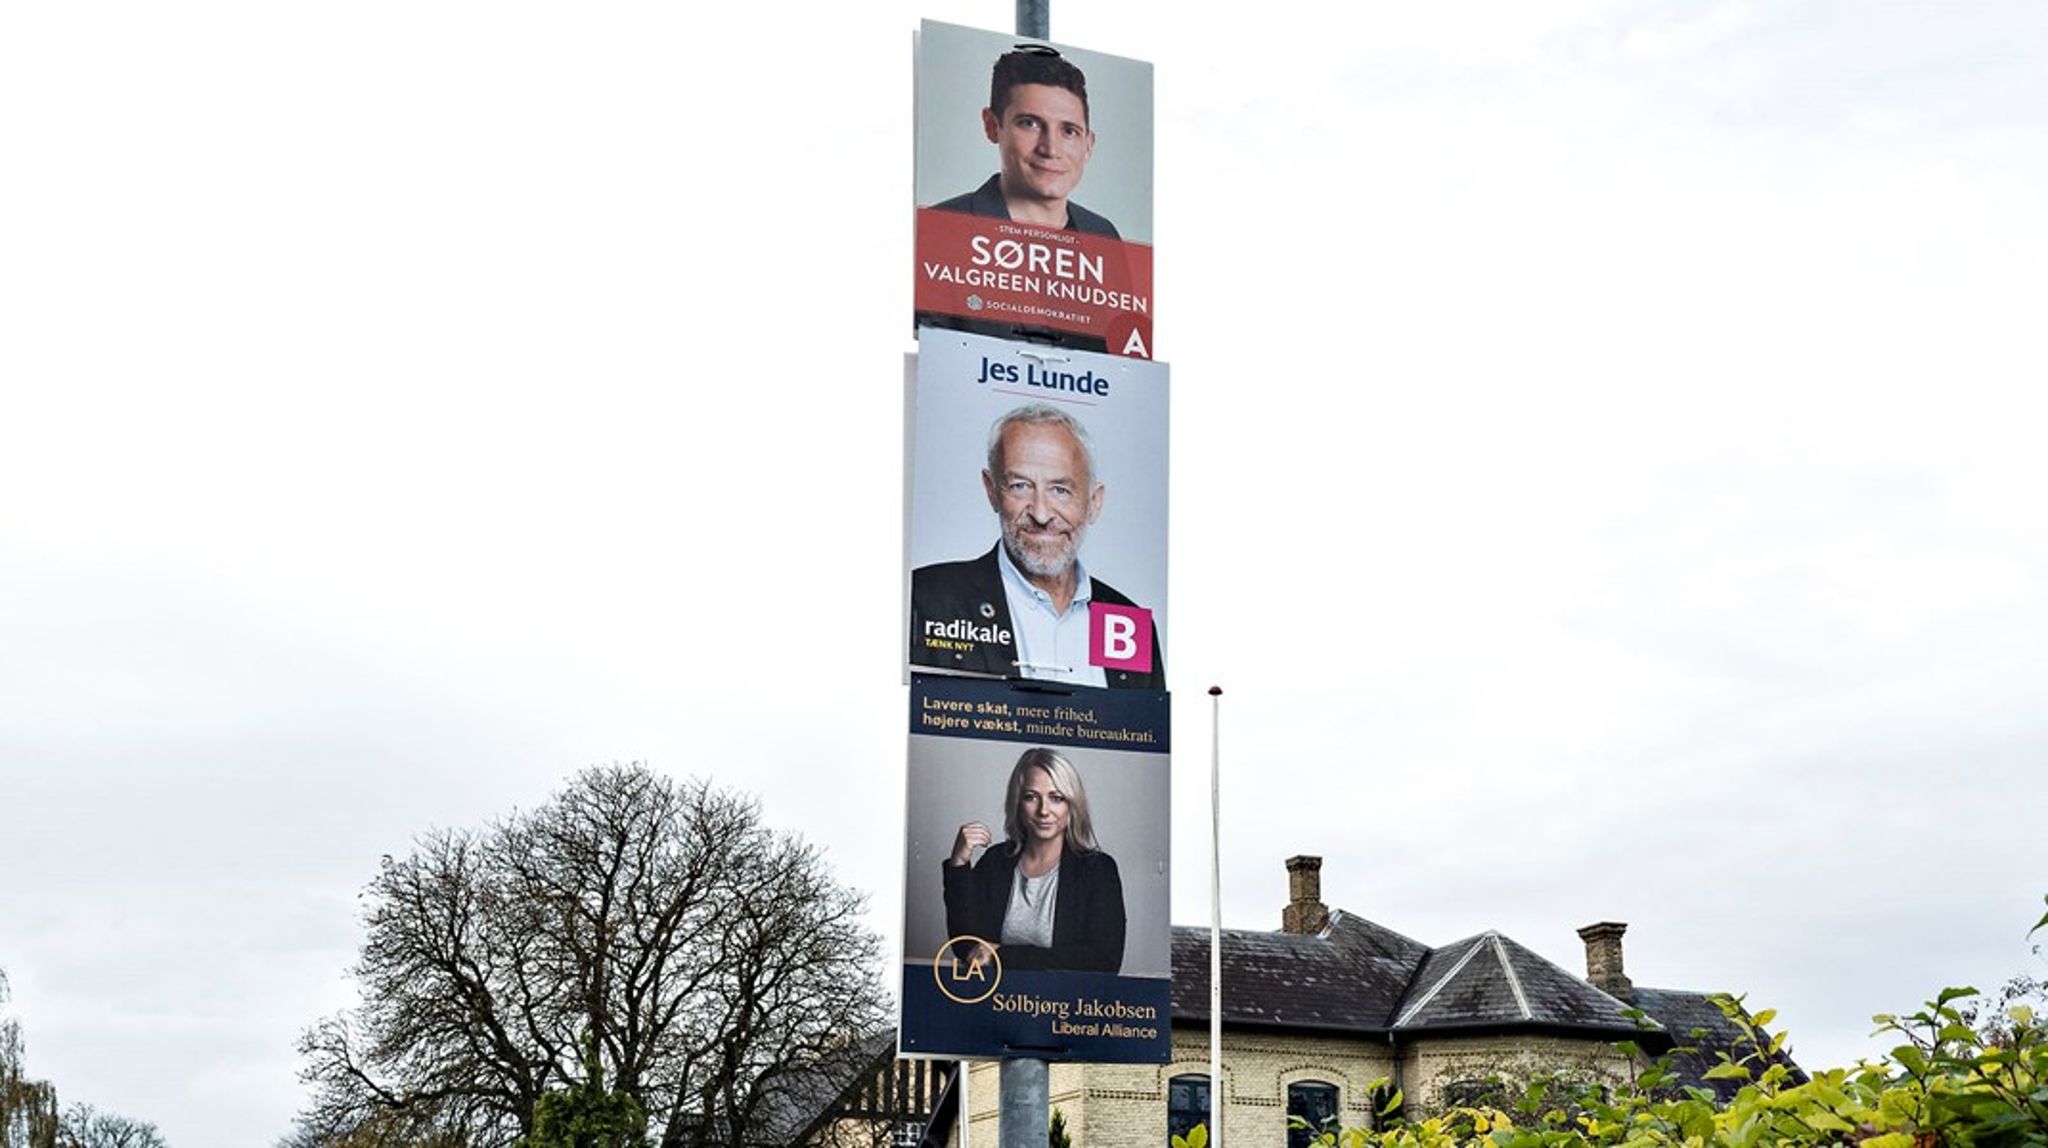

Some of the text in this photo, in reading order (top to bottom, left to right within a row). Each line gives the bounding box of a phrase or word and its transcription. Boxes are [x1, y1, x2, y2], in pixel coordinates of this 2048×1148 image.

[999, 225, 1075, 244] STEM PERSONLIGT
[971, 236, 1104, 284] SØREN
[924, 262, 1148, 313] VALGREEN KNUDSEN
[987, 301, 1091, 324] SOCIALDEMOKRATIET
[1122, 327, 1149, 358] A
[978, 357, 1109, 396] Jes Lunde
[924, 638, 975, 652] TÆNK NYT
[925, 619, 1011, 645] radikale
[1104, 613, 1137, 660] B
[923, 696, 1097, 724] Lavere skat, mere frihed,
[923, 712, 1157, 743] højere vækst, mindre bureaukrati.
[953, 958, 985, 982] LA
[992, 993, 1157, 1019] Sólbjørg Jakobsen
[1052, 1021, 1158, 1039] Liberal Alliance
